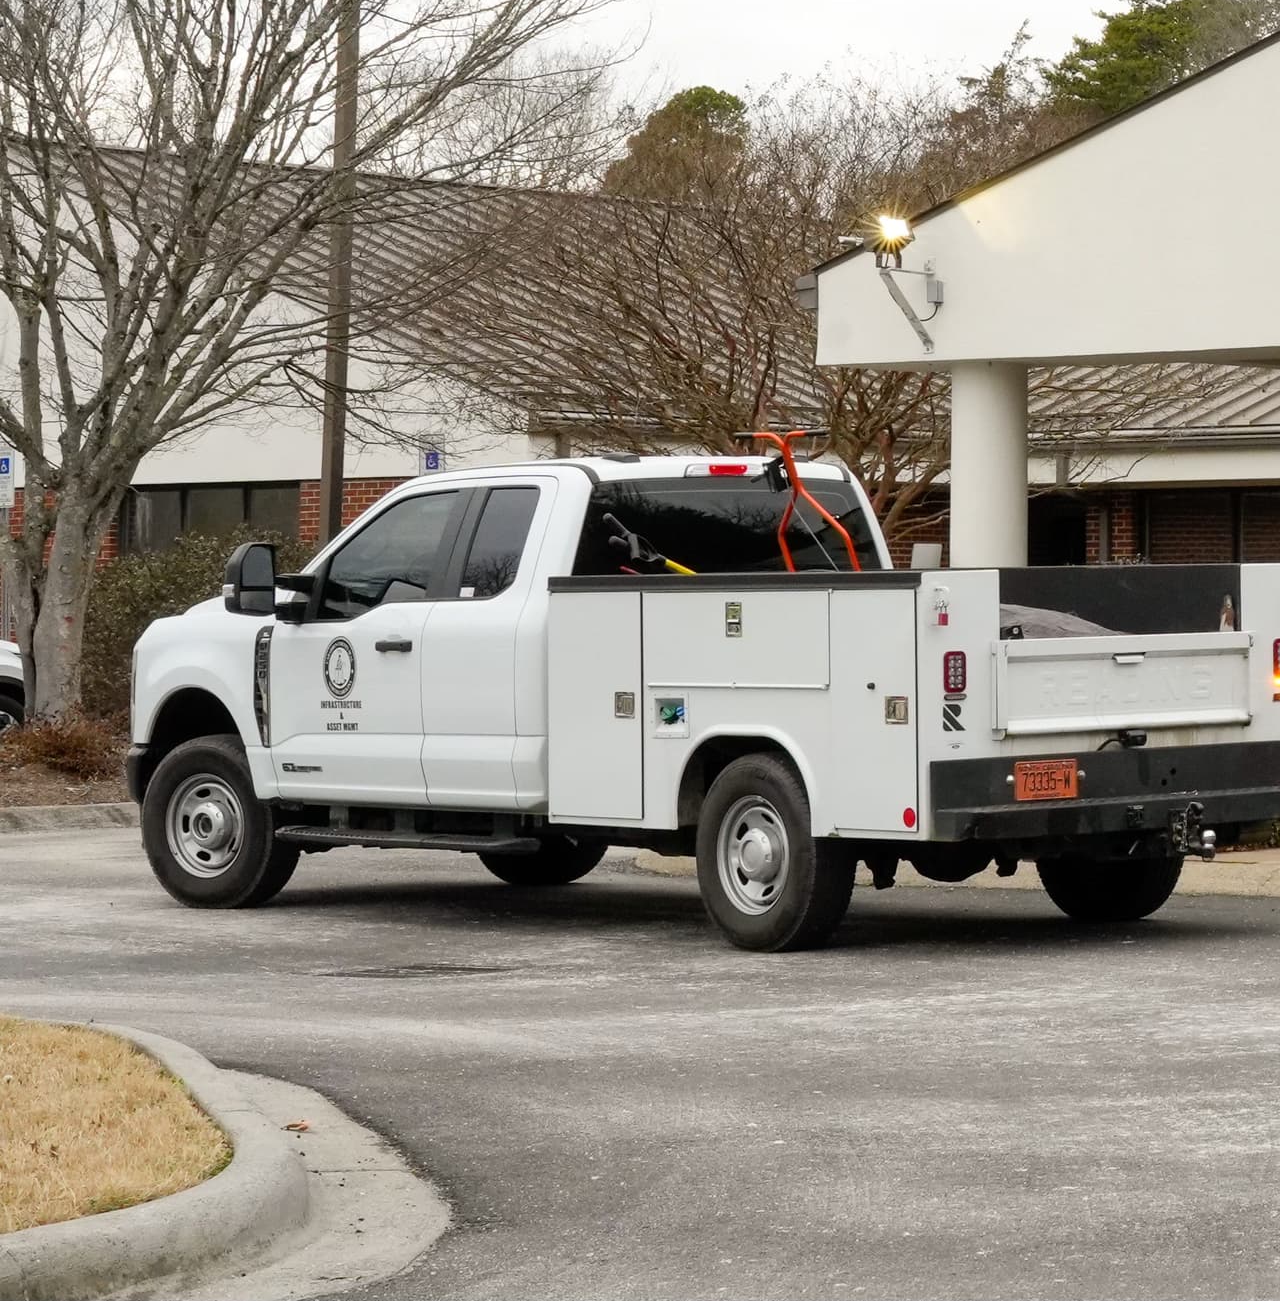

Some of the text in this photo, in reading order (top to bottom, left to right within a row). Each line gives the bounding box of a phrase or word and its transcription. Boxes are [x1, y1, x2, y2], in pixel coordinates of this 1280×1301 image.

[320, 700, 362, 709] INFRASTRUCTURE
[326, 723, 359, 731] ASSET MGMT
[1022, 770, 1071, 793] 73335-W
